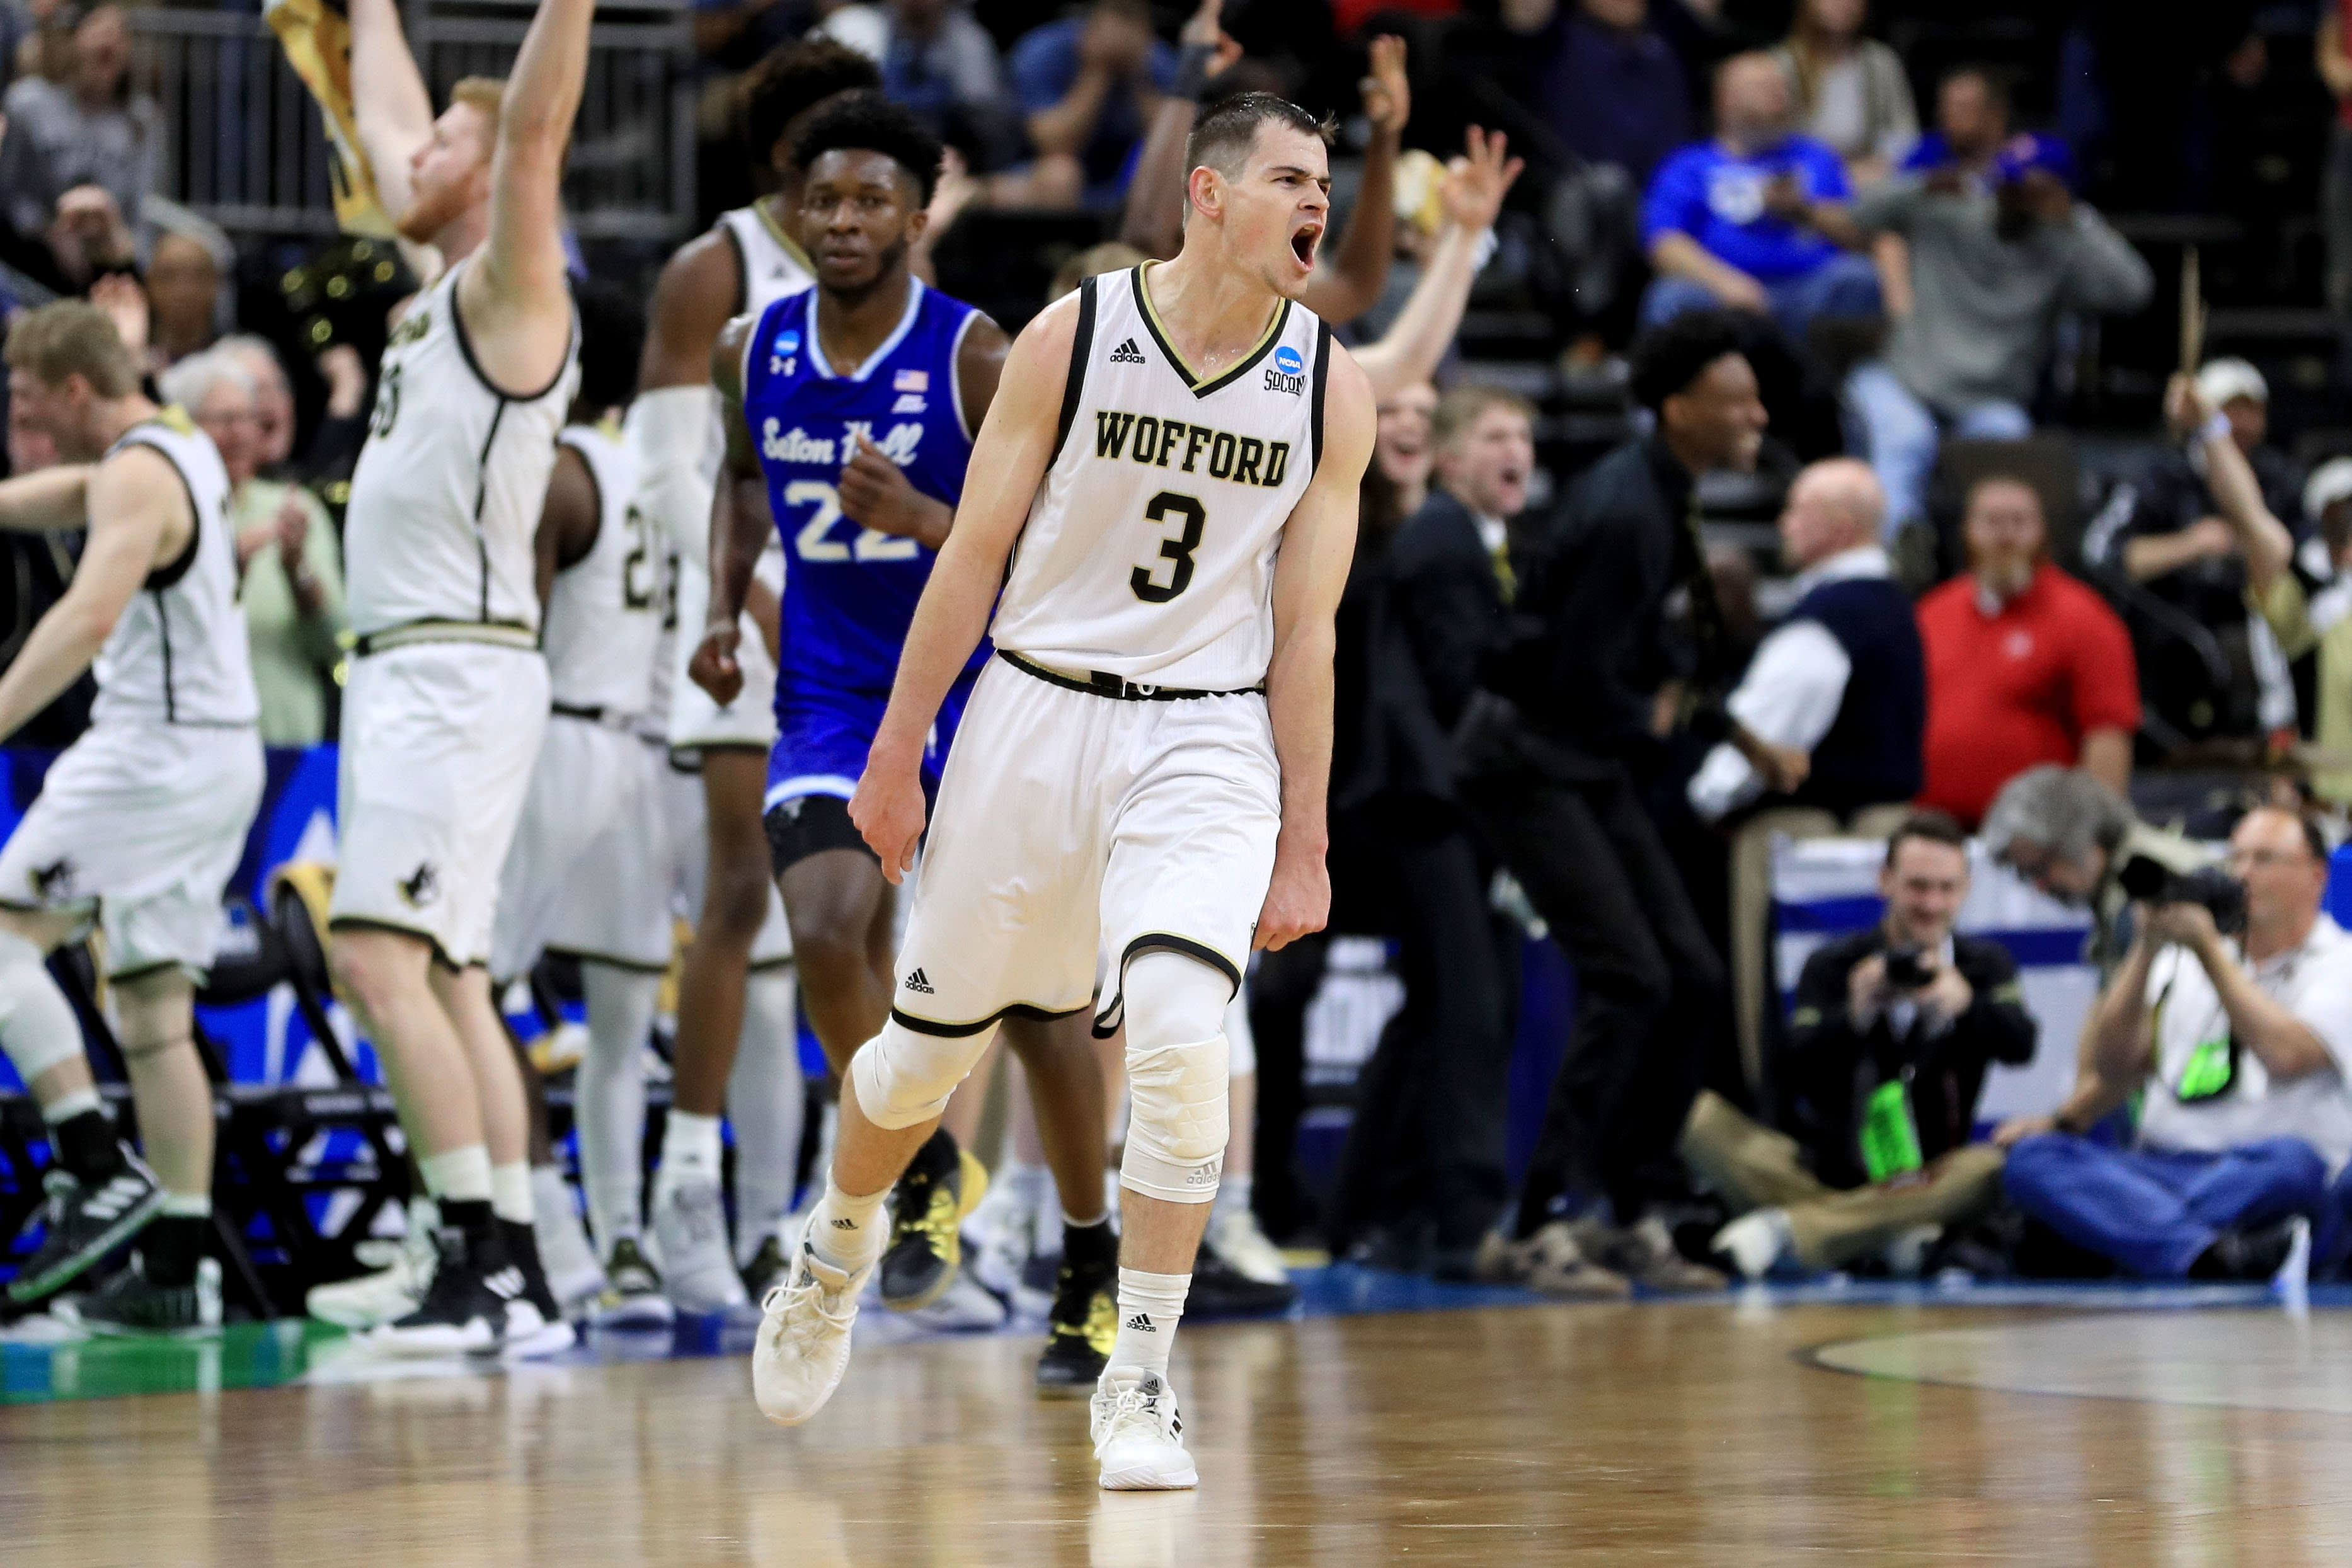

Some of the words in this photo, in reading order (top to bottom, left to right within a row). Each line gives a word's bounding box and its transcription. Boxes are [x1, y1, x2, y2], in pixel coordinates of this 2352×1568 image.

[1110, 353, 1145, 363] adidas
[1279, 357, 1301, 369] NCAA
[763, 416, 835, 465] Seton
[1095, 410, 1290, 488] WOFFORD
[1128, 489, 1207, 603] 3
[905, 980, 934, 994] adidas
[1127, 1322, 1157, 1332] adidas
